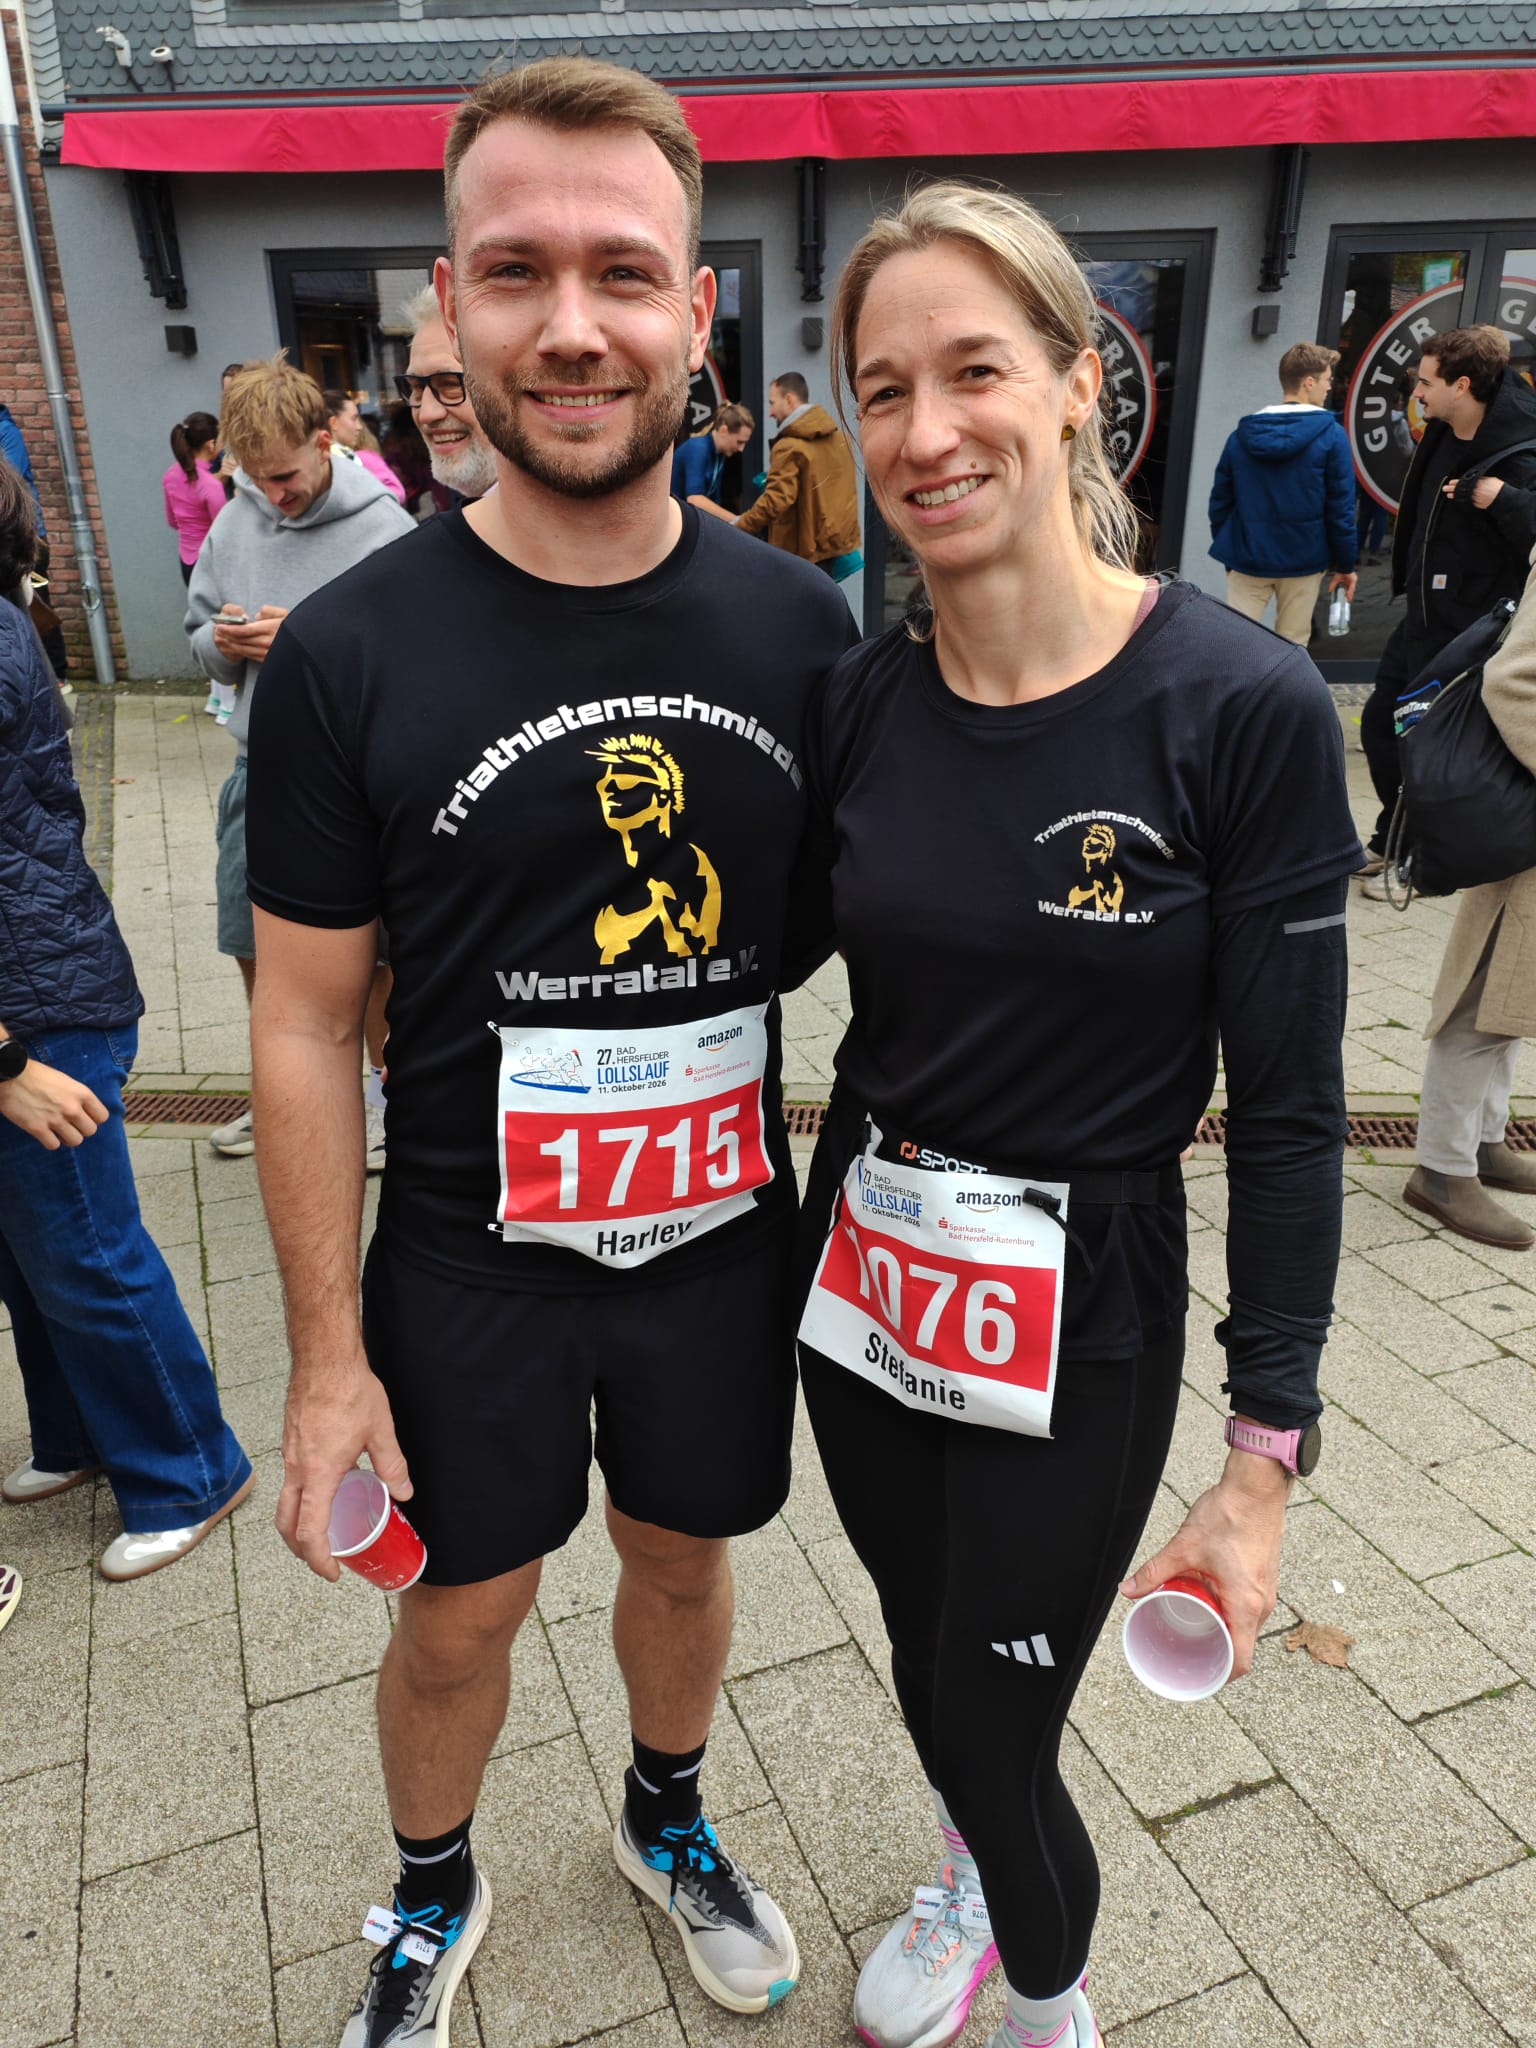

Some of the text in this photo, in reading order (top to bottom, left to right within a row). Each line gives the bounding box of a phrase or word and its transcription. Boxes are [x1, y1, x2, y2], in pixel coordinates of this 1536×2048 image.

[1363, 317, 1437, 453] GUTER
[431, 694, 804, 836] Triathletenschmiede
[1034, 809, 1175, 861] Triathletenschmiede
[1038, 900, 1156, 923] Werratal e.V.
[494, 945, 759, 1000] Werratal e.V.
[698, 1026, 742, 1048] amazon
[597, 1049, 615, 1066] 27.
[617, 1047, 636, 1056] BAD
[617, 1051, 669, 1064] HERSFELDER
[598, 1061, 670, 1084] LOLLSLAUF
[612, 1083, 645, 1093] Oktober
[648, 1080, 666, 1089] 2026
[540, 1103, 740, 1209] 1715
[874, 1173, 891, 1184] BAD
[862, 1185, 922, 1218] LOLLSLAUF
[875, 1182, 922, 1201] HERSFELDER
[956, 1191, 1021, 1207] amazon
[872, 1208, 902, 1220] Oktober
[904, 1216, 921, 1227] 2026
[949, 1223, 986, 1234] Sparkasse
[948, 1232, 1035, 1246] Bad Hersfeld-Rotenburg
[844, 1225, 1016, 1365] 1076
[864, 1332, 966, 1411] Stefanie
